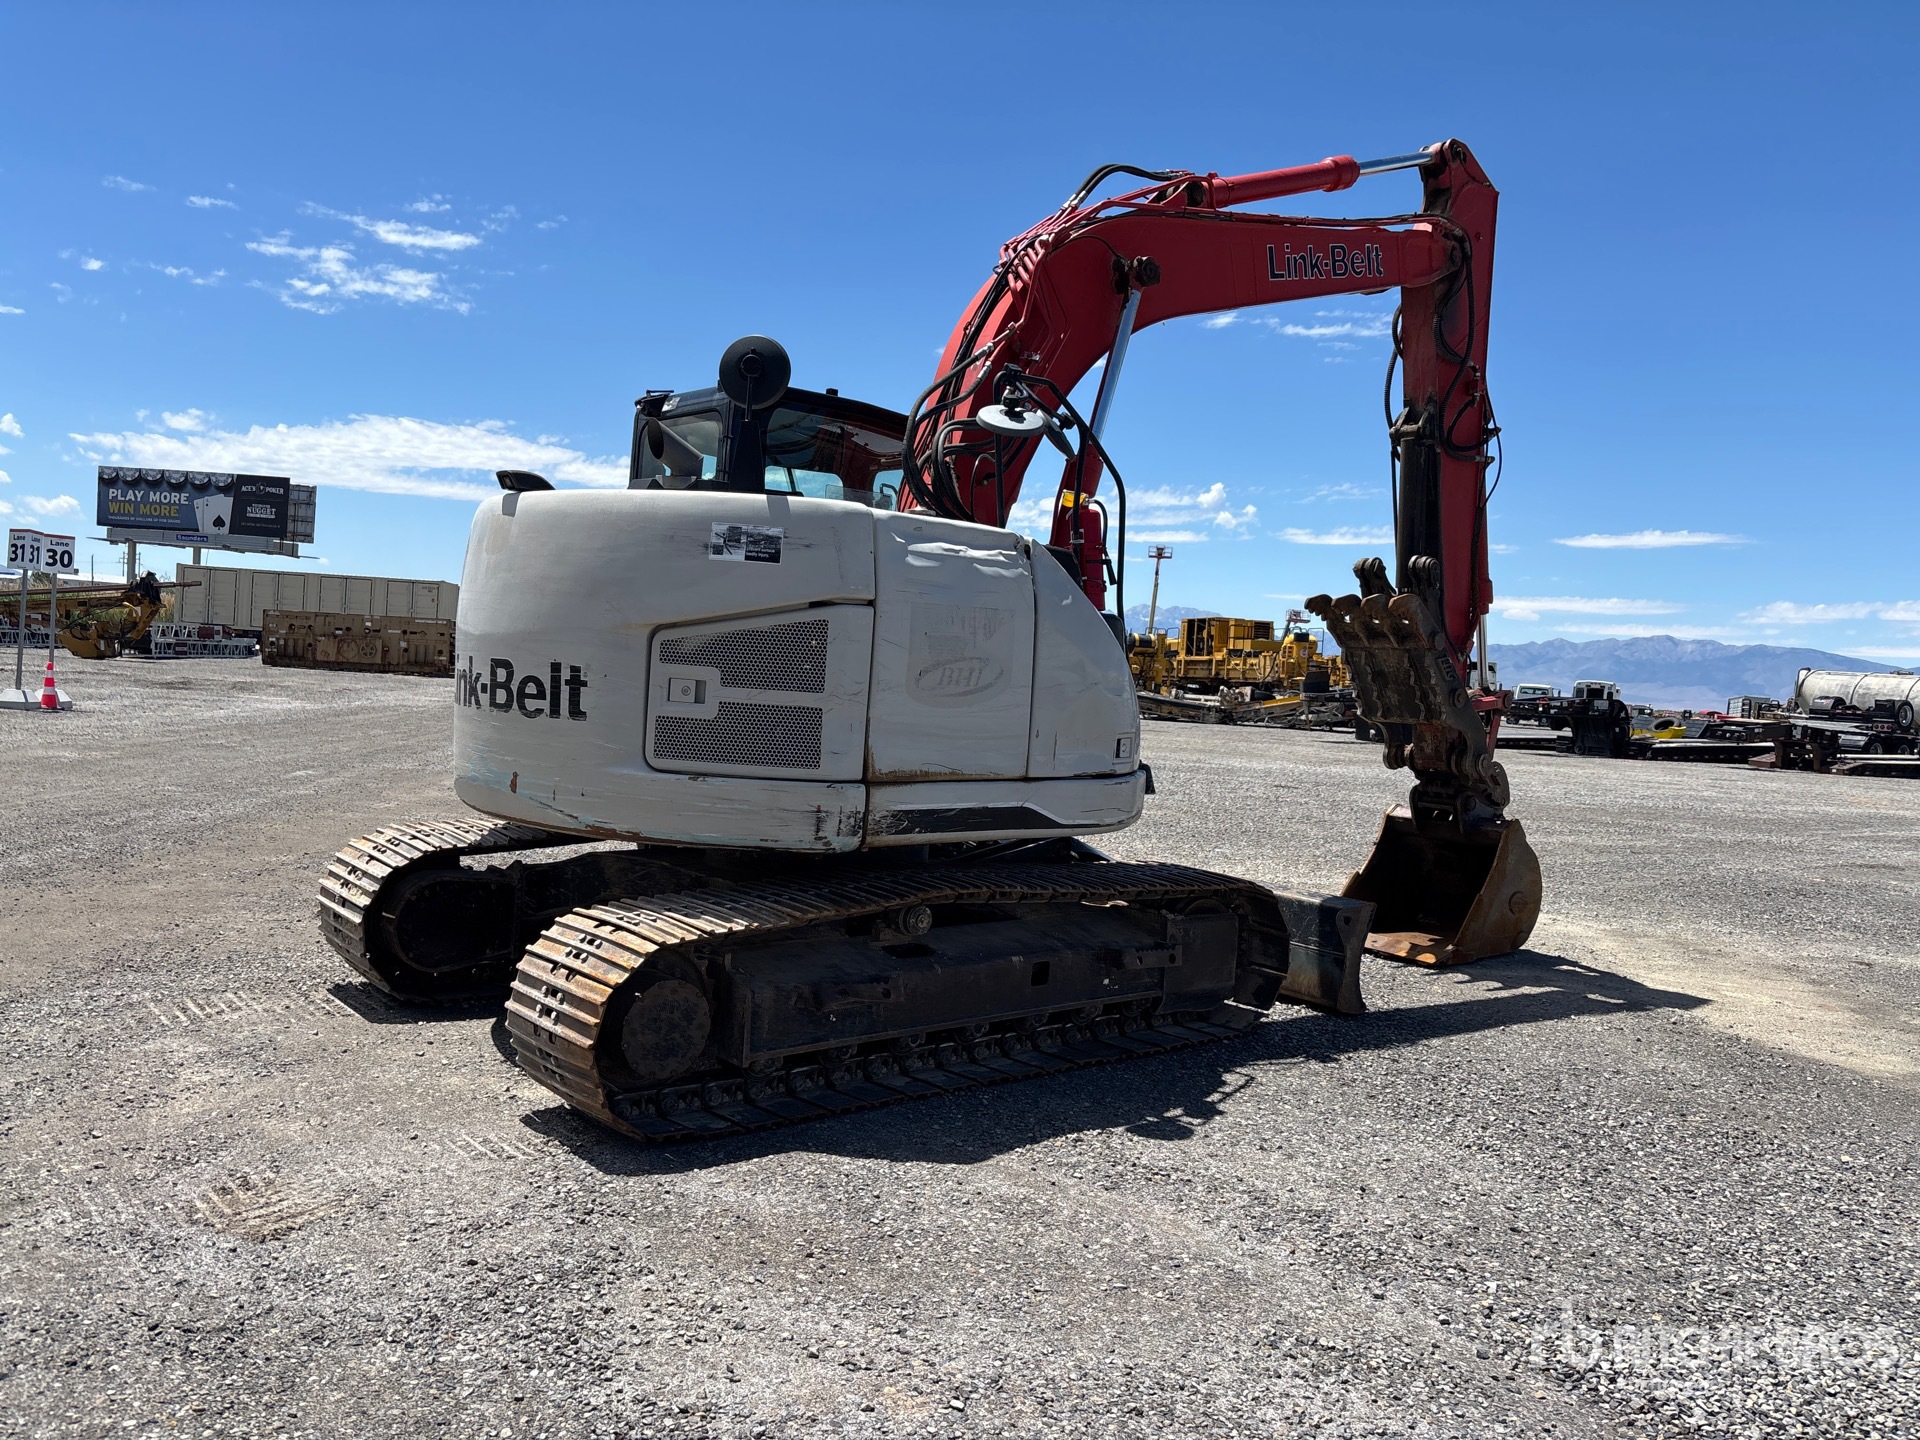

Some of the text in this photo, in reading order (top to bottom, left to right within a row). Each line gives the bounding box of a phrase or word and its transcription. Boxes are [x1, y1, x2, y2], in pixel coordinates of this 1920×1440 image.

[1267, 243, 1384, 281] Link-Belt
[109, 488, 144, 502] PLAY
[265, 486, 284, 495] POKER
[108, 501, 134, 514] WIN
[246, 506, 276, 515] NUGGET
[50, 539, 70, 547] Lane
[177, 534, 207, 542] Saunders
[9, 543, 26, 562] 31
[28, 544, 40, 564] 31
[45, 548, 73, 568] 30
[455, 654, 588, 721] ink-Belt
